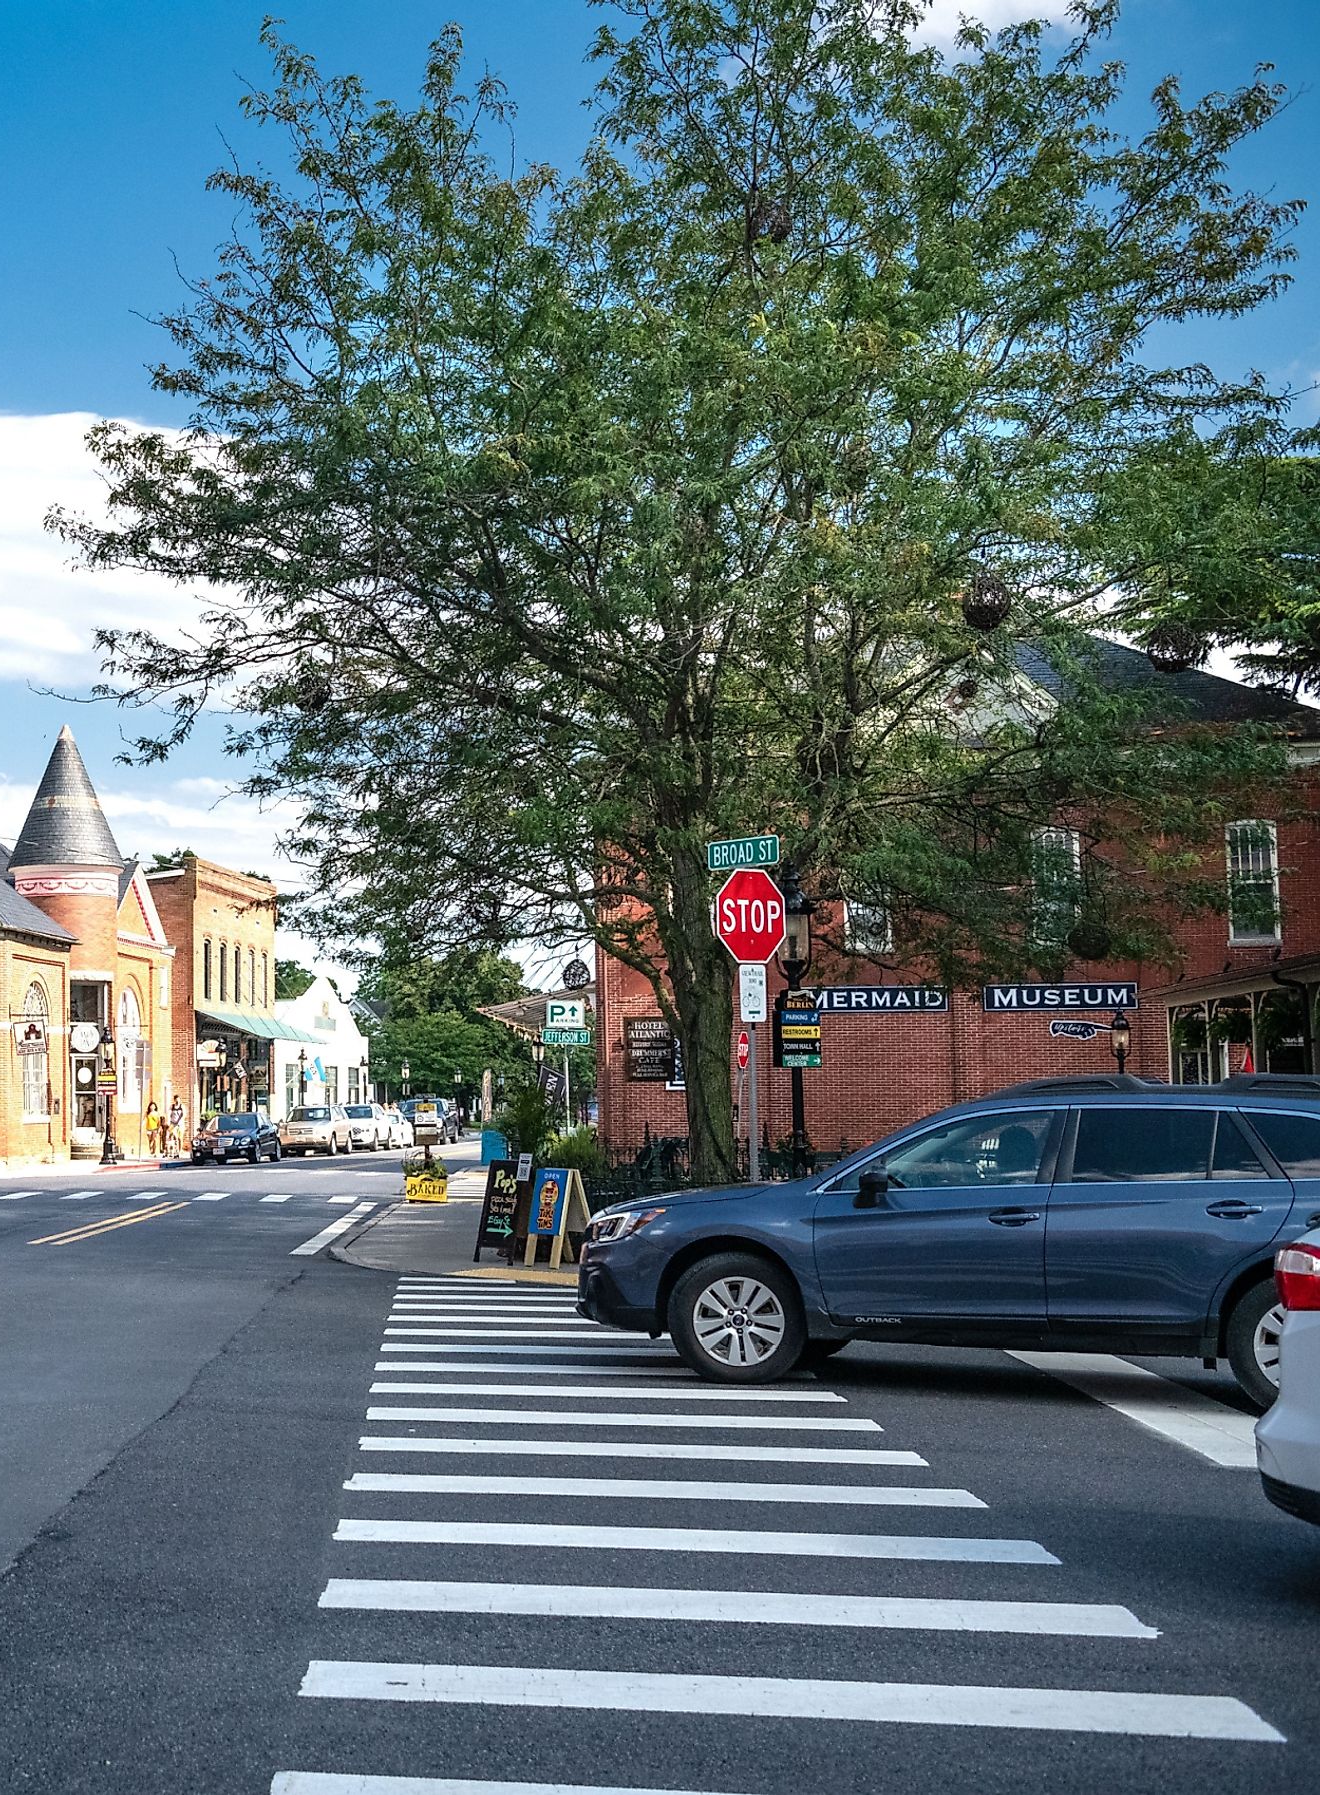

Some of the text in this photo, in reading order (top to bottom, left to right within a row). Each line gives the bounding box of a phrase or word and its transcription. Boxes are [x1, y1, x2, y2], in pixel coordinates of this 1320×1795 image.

[713, 839, 773, 866] BROAD ST
[722, 898, 780, 933] STOP
[815, 988, 942, 1009] MERMAID
[993, 988, 1129, 1007] MUSEUM
[629, 1030, 671, 1039] ATLANTIC
[635, 1021, 664, 1029] HOTEL
[544, 1031, 587, 1043] JEFFERSON ST
[407, 1184, 444, 1196] BAKED
[494, 1169, 517, 1193] Pop's
